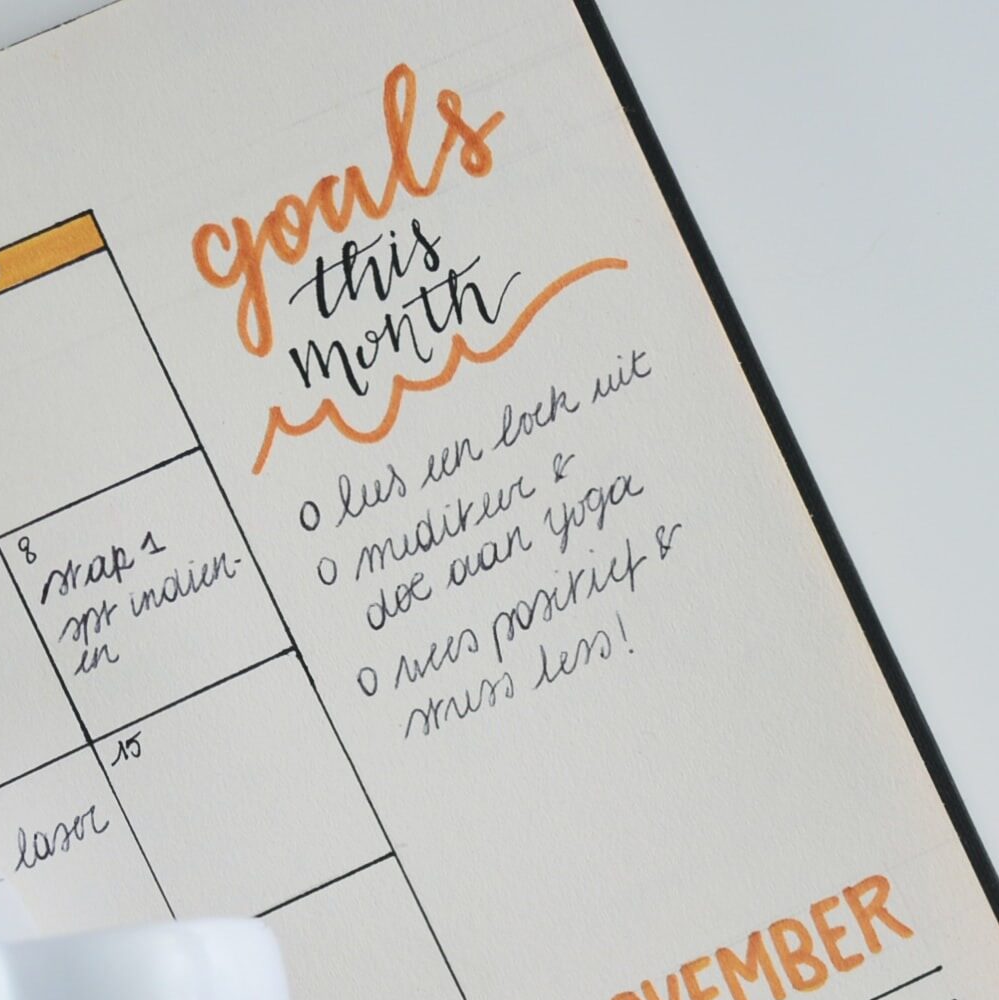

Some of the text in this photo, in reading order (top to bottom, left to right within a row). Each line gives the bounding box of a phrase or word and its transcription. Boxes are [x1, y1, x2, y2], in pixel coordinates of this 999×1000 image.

[192, 63, 505, 357] goals
[289, 219, 441, 318] this
[289, 255, 521, 396] month
[336, 464, 407, 527] lees
[421, 438, 483, 488] een
[592, 350, 652, 403] uit
[18, 536, 37, 564] 8
[140, 531, 167, 555] 1
[356, 476, 536, 581] mediteer
[367, 475, 644, 630] doe aan yoga
[74, 643, 120, 676] en
[394, 628, 479, 690] wees
[493, 538, 647, 663] positief
[405, 610, 634, 739] stress less!
[110, 730, 143, 768] 15
